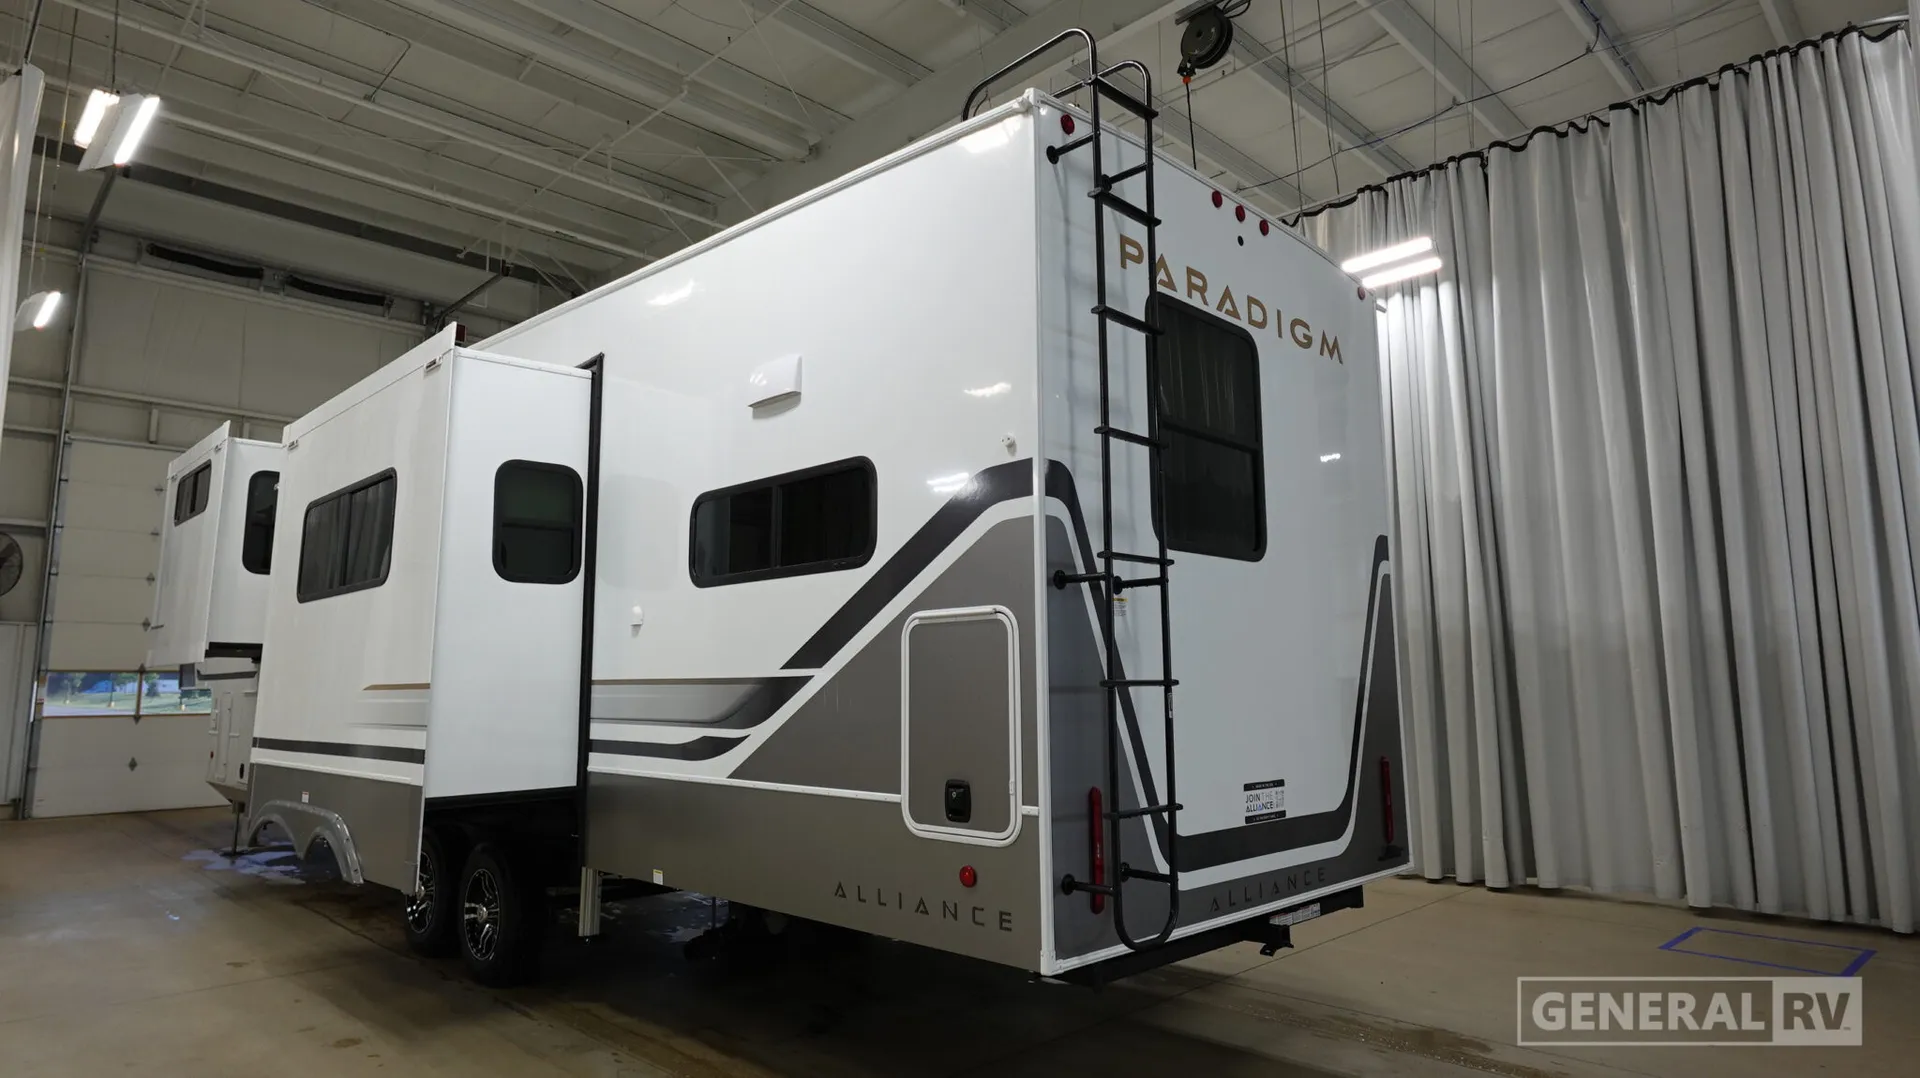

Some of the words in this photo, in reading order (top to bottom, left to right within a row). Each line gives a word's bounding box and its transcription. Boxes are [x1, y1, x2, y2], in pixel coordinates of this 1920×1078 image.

[1119, 233, 1344, 366] PARADIGM
[1245, 793, 1261, 804] JOIN
[834, 881, 1012, 932] ALLIANCE
[1210, 866, 1326, 913] ALLIANCE
